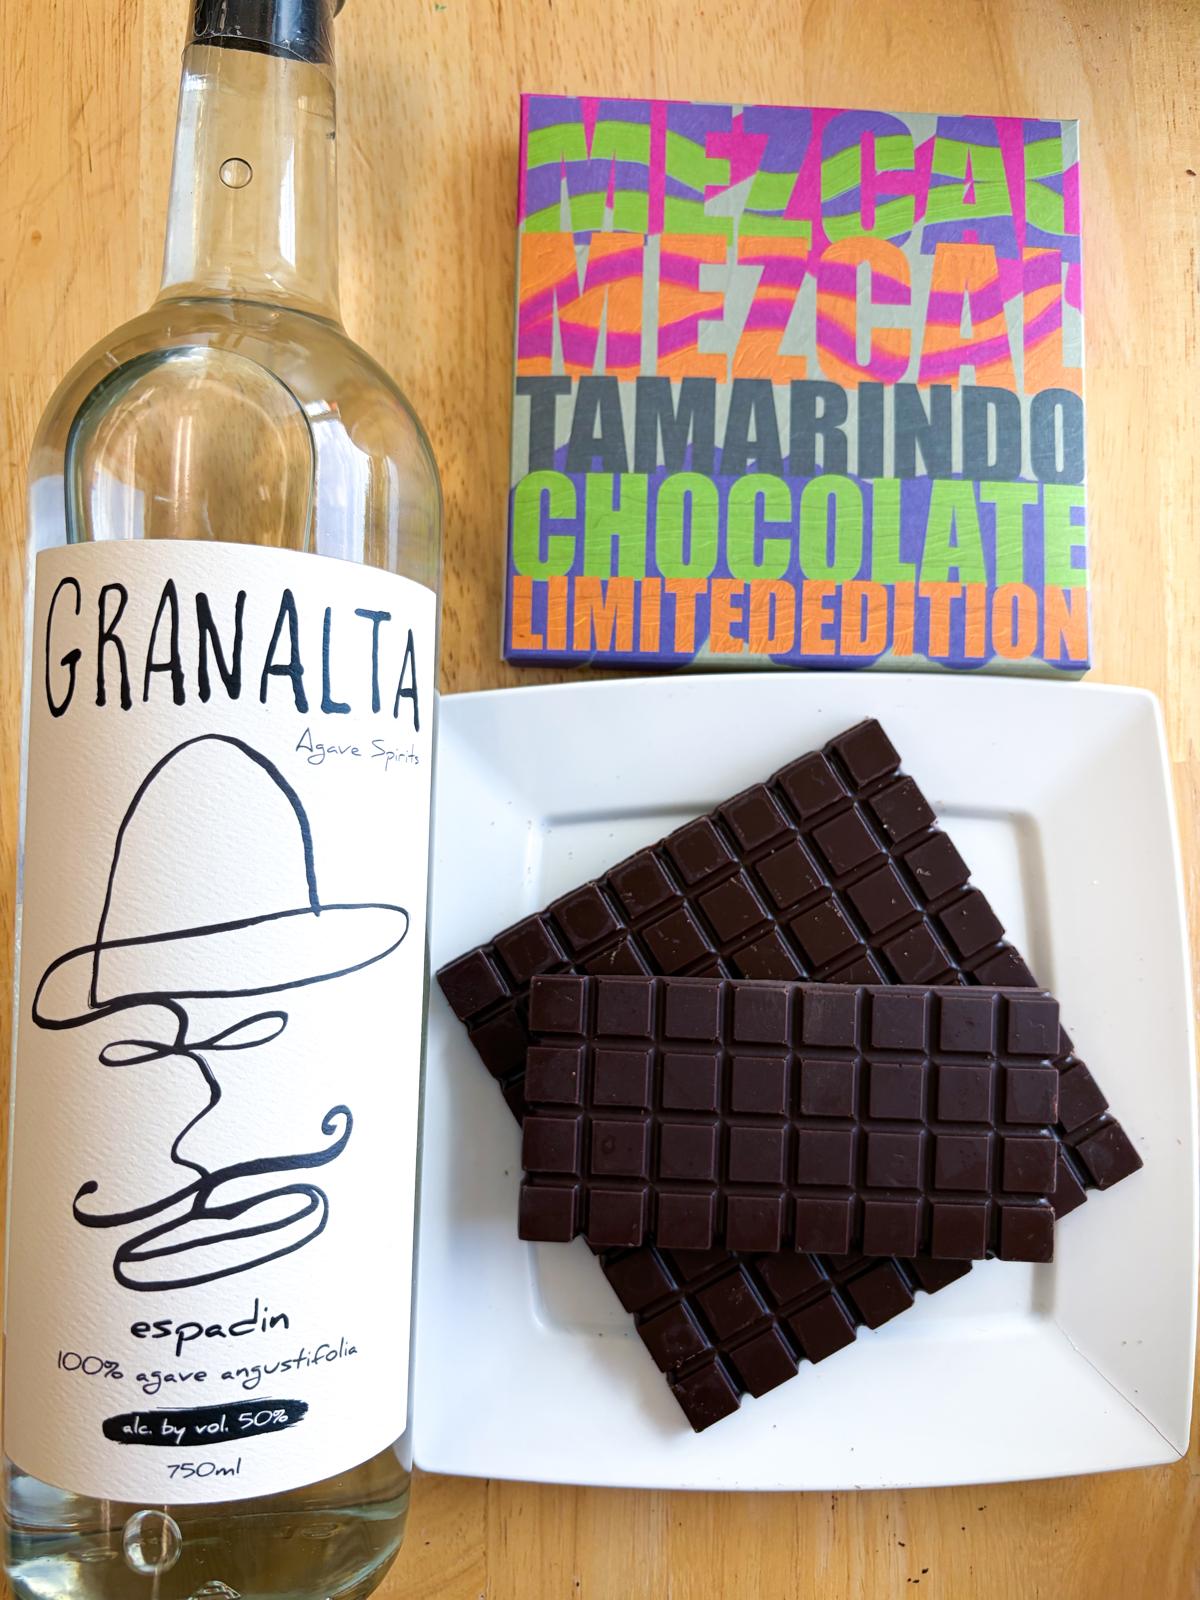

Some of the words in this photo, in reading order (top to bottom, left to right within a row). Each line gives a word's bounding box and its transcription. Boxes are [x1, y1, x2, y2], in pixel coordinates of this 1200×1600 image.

[522, 98, 1082, 263] MEZCAL
[516, 232, 1084, 394] MEZCAL
[515, 375, 1085, 485] TAMARINDO
[512, 470, 1088, 587] CHOCOLATE
[45, 576, 421, 732] GRANALTA
[295, 727, 362, 766] Agave
[371, 739, 420, 772] Spirits
[57, 1350, 124, 1380] 100%
[136, 1369, 207, 1394] agave
[221, 1337, 358, 1390] angustifolia
[130, 1298, 290, 1357] espadin
[122, 1416, 153, 1435] alc.
[161, 1419, 187, 1445] by
[195, 1415, 230, 1434] vol.
[238, 1407, 289, 1430] 50%
[167, 1457, 242, 1479] 750ml
